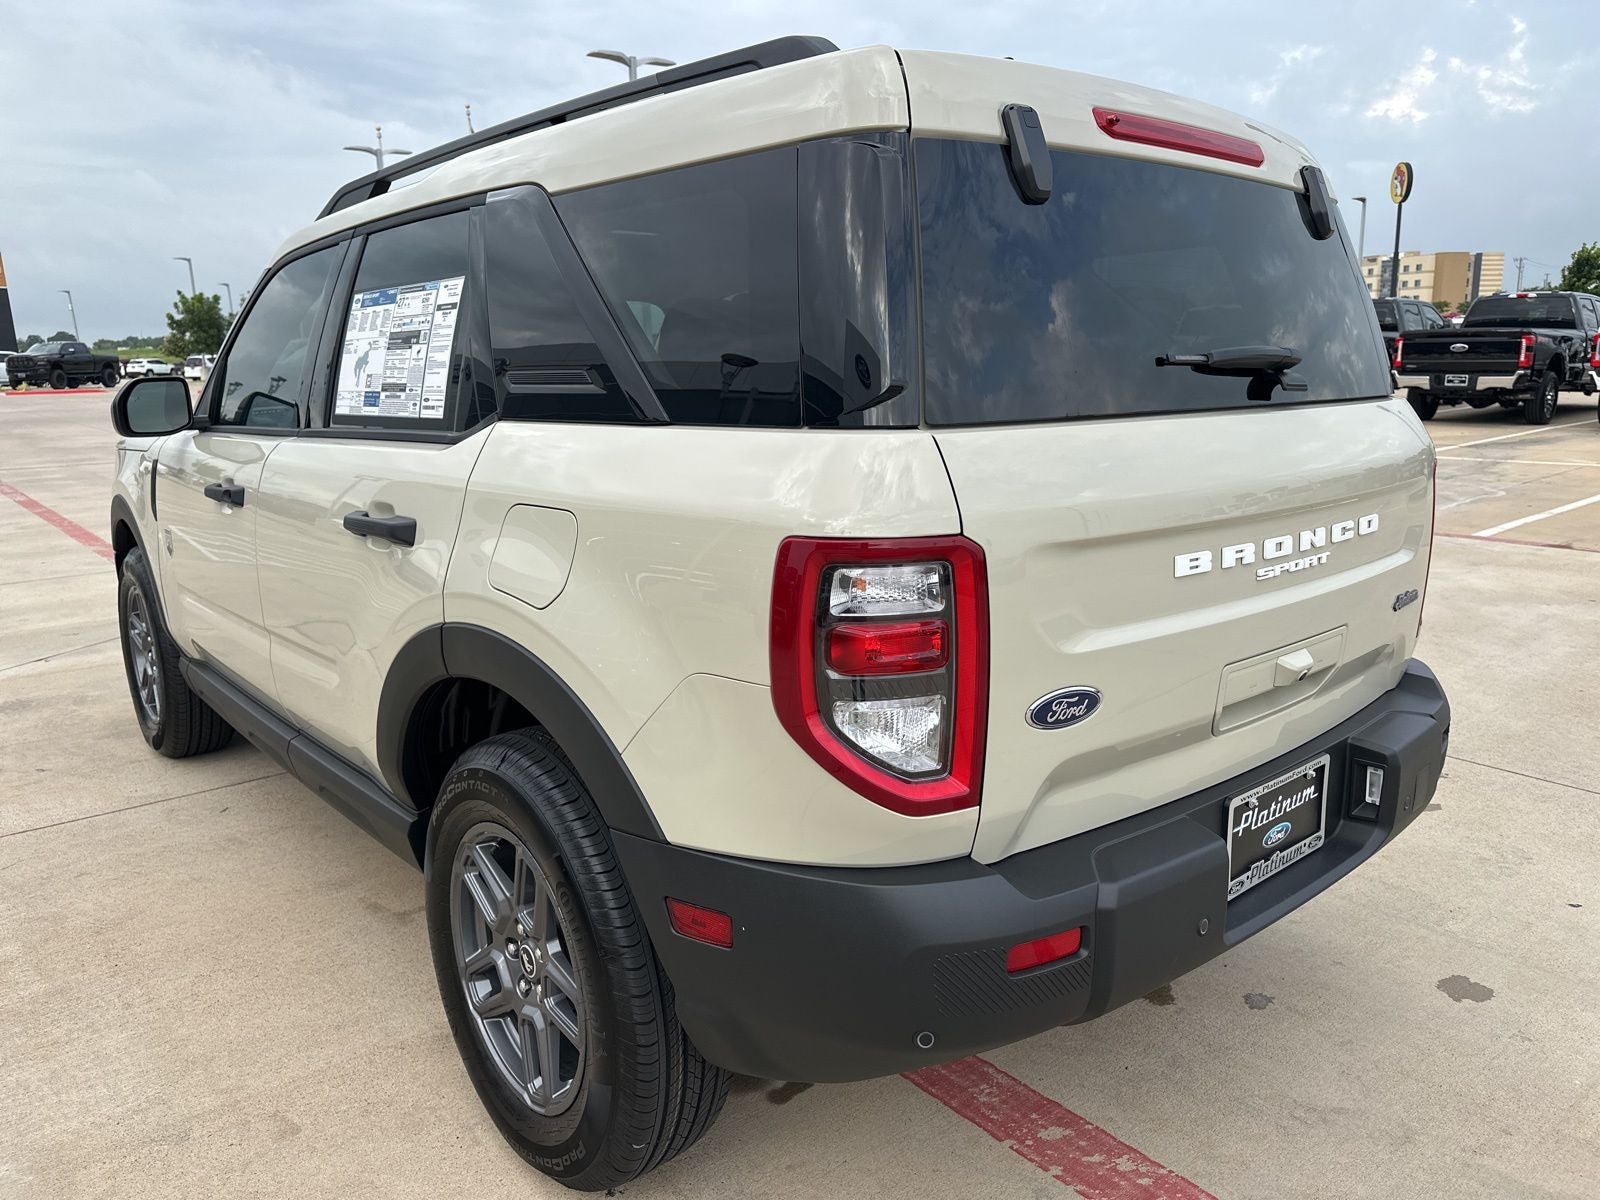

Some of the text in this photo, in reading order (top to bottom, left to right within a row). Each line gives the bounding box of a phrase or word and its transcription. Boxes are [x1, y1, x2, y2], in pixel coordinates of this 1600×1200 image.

[1174, 513, 1379, 579] BRONCO
[1256, 551, 1331, 581] SPORT
[1046, 696, 1089, 723] Ford
[1240, 760, 1322, 803] www.PlatinumFord.com
[1232, 785, 1319, 837] Platinum
[1249, 850, 1306, 885] Platinum
